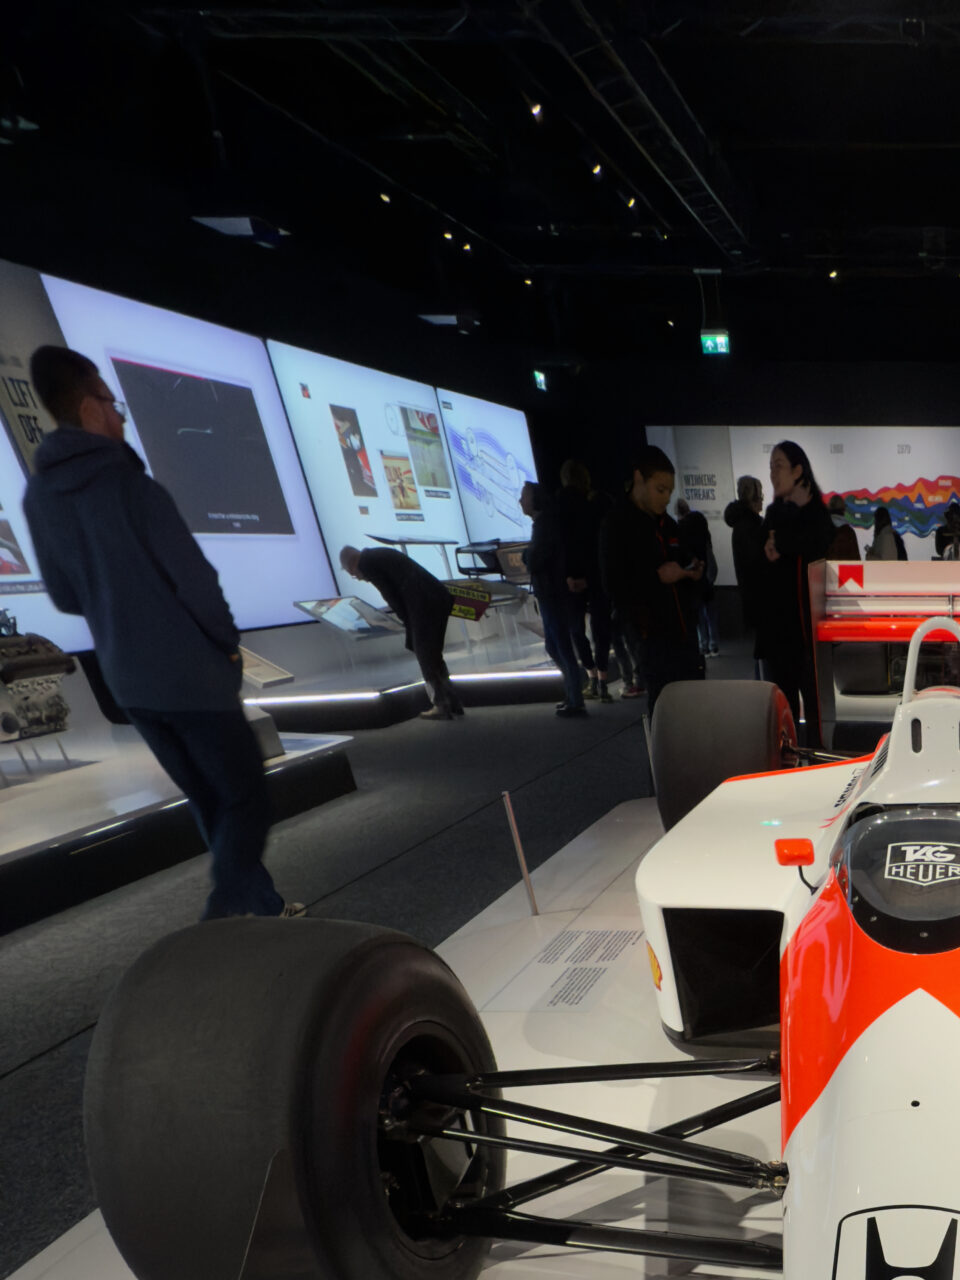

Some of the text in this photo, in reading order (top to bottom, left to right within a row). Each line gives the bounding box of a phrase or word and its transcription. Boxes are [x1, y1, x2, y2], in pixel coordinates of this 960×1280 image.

[683, 474, 717, 487] WINNING
[685, 488, 716, 501] STREAKS
[901, 845, 956, 862] TAG
